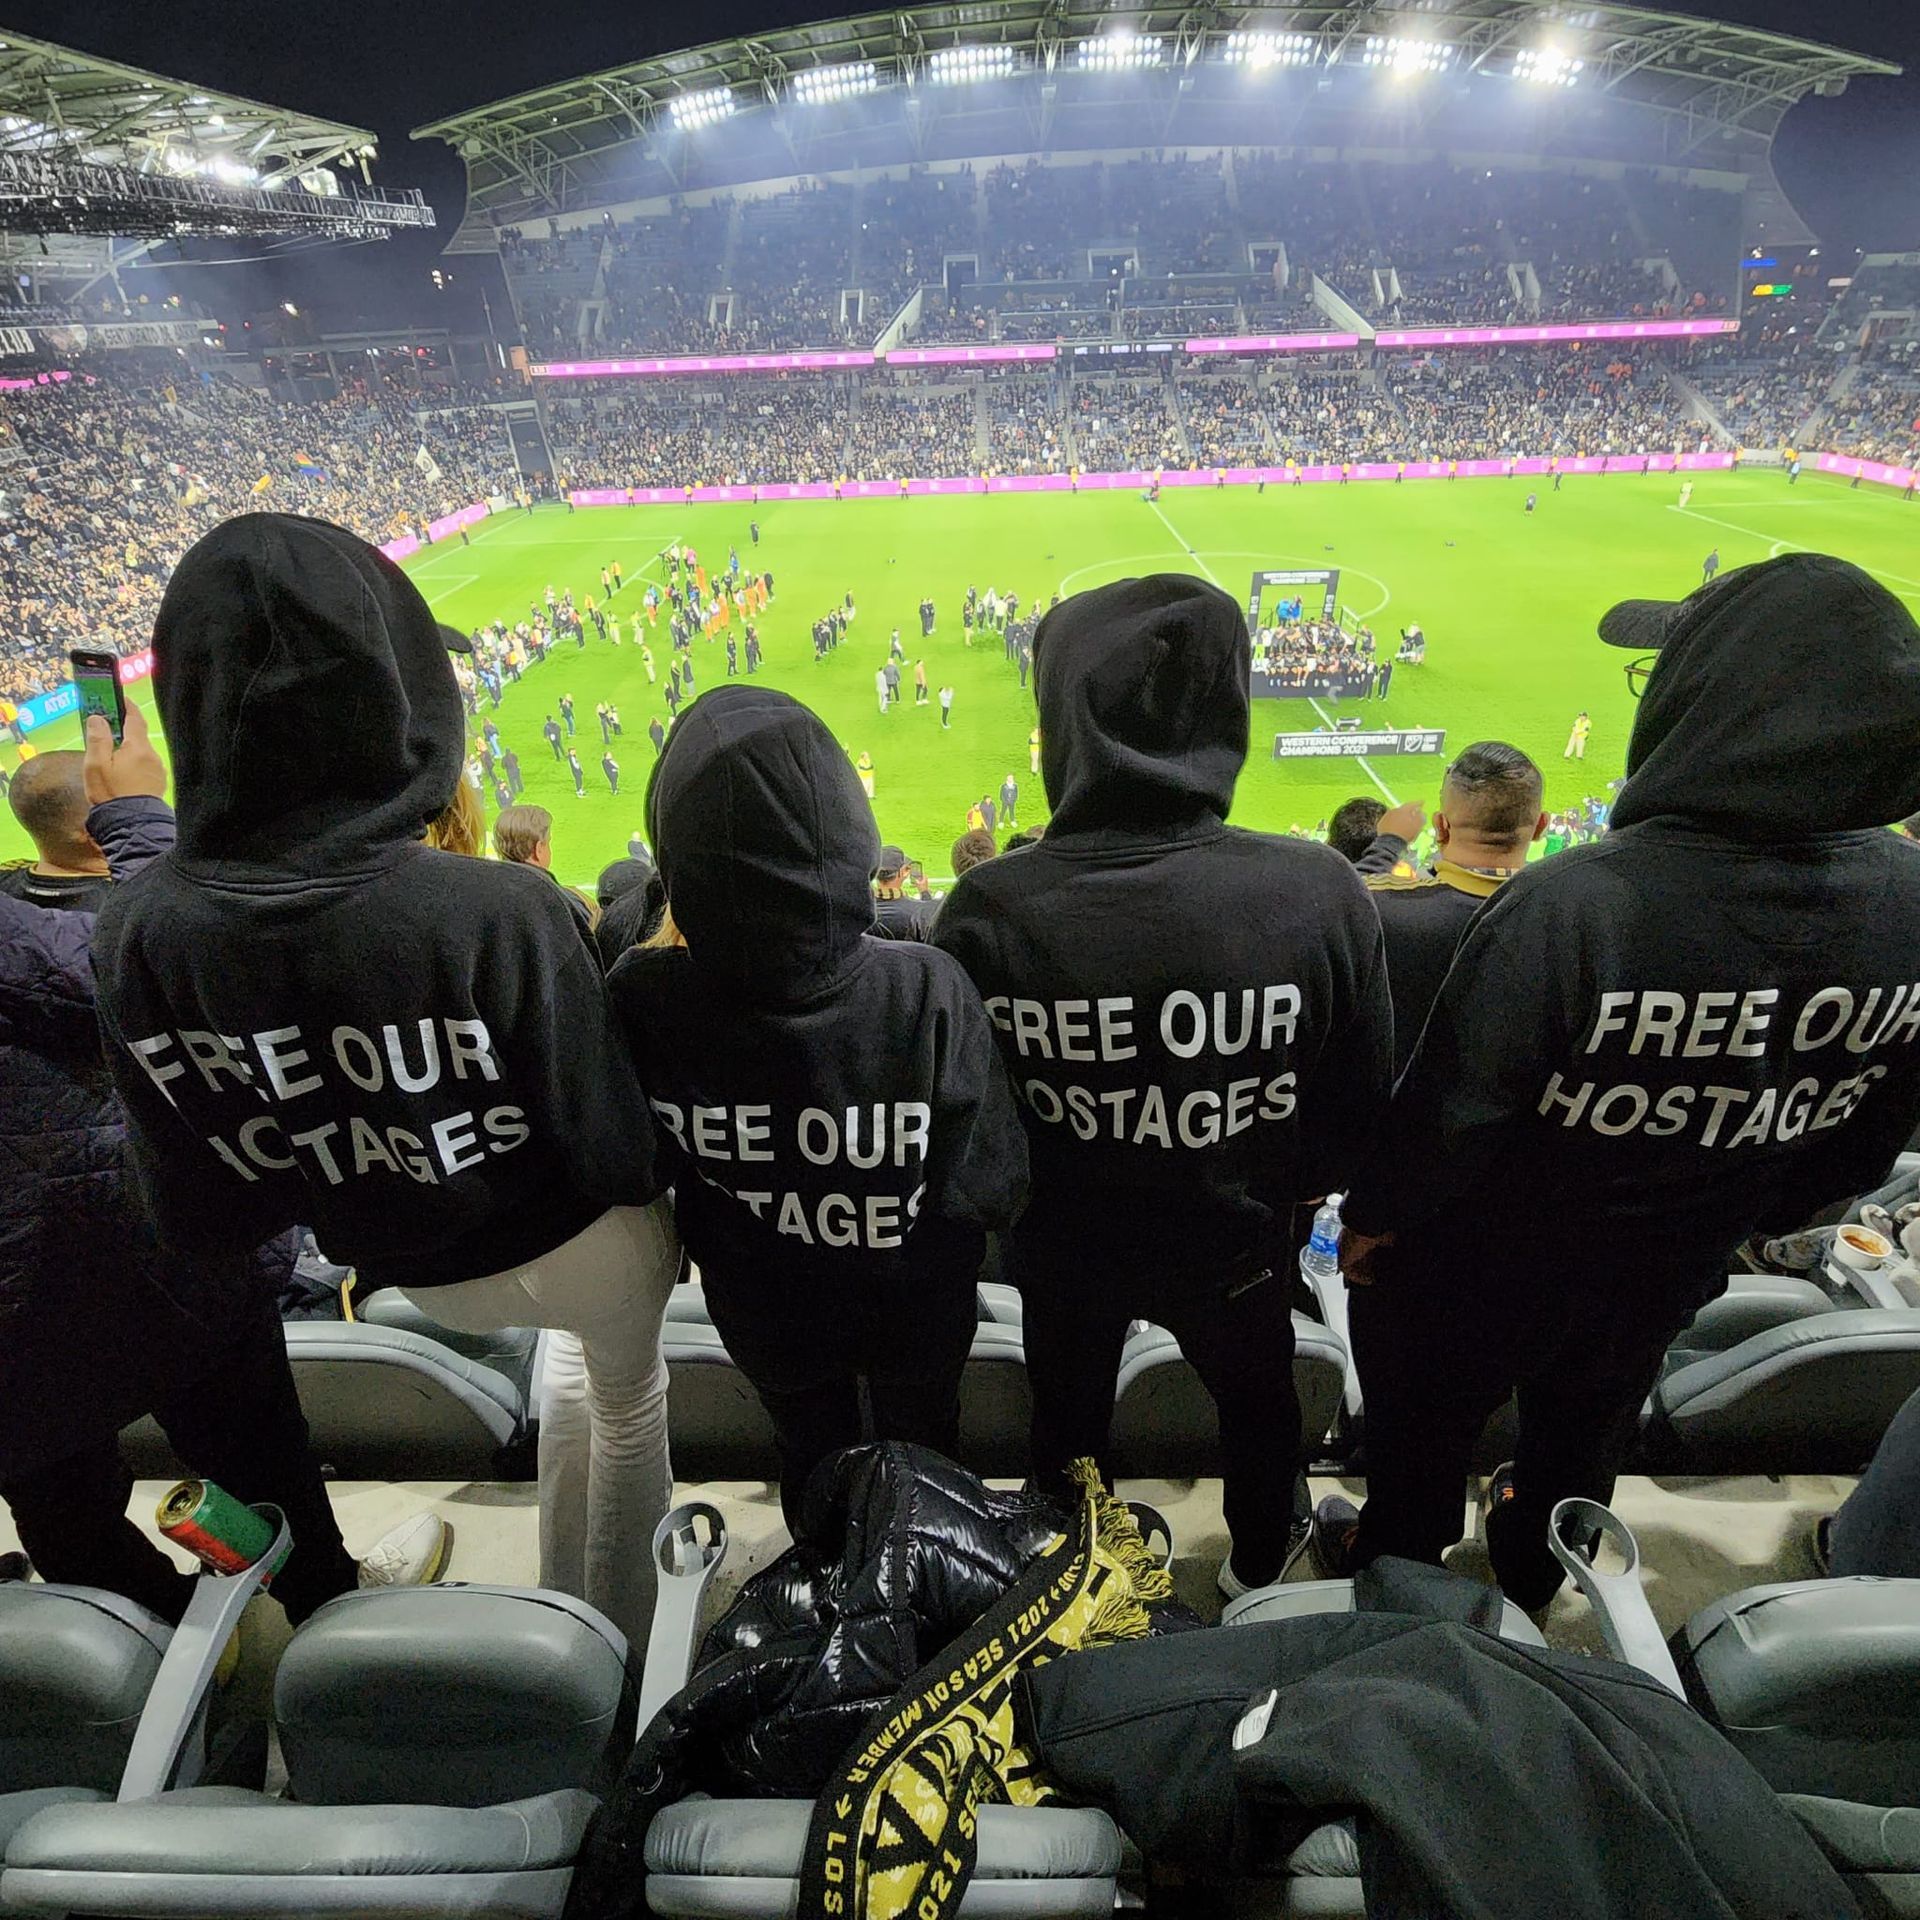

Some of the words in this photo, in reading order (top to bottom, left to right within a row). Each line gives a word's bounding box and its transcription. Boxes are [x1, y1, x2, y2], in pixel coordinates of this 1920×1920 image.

[1280, 746, 1341, 756] CHAMPIONS
[1343, 745, 1368, 754] 2023
[1281, 737, 1331, 746] WESTERN
[1331, 735, 1399, 745] CONFERENCE
[331, 1017, 500, 1094] OUR
[982, 996, 1137, 1061] FREE
[1160, 983, 1301, 1059] OUR
[1584, 989, 1779, 1058] FREE
[650, 1097, 775, 1162] REE
[798, 1102, 931, 1170] OUR
[1025, 1071, 1297, 1149] OSTAGES
[1058, 1552, 1085, 1592] CLUB
[1007, 1596, 1050, 1645] 2021
[923, 1638, 1004, 1712] SEASON
[847, 1700, 923, 1784] MEMBER
[823, 1831, 847, 1915] LOS
[918, 1849, 962, 1920] 021
